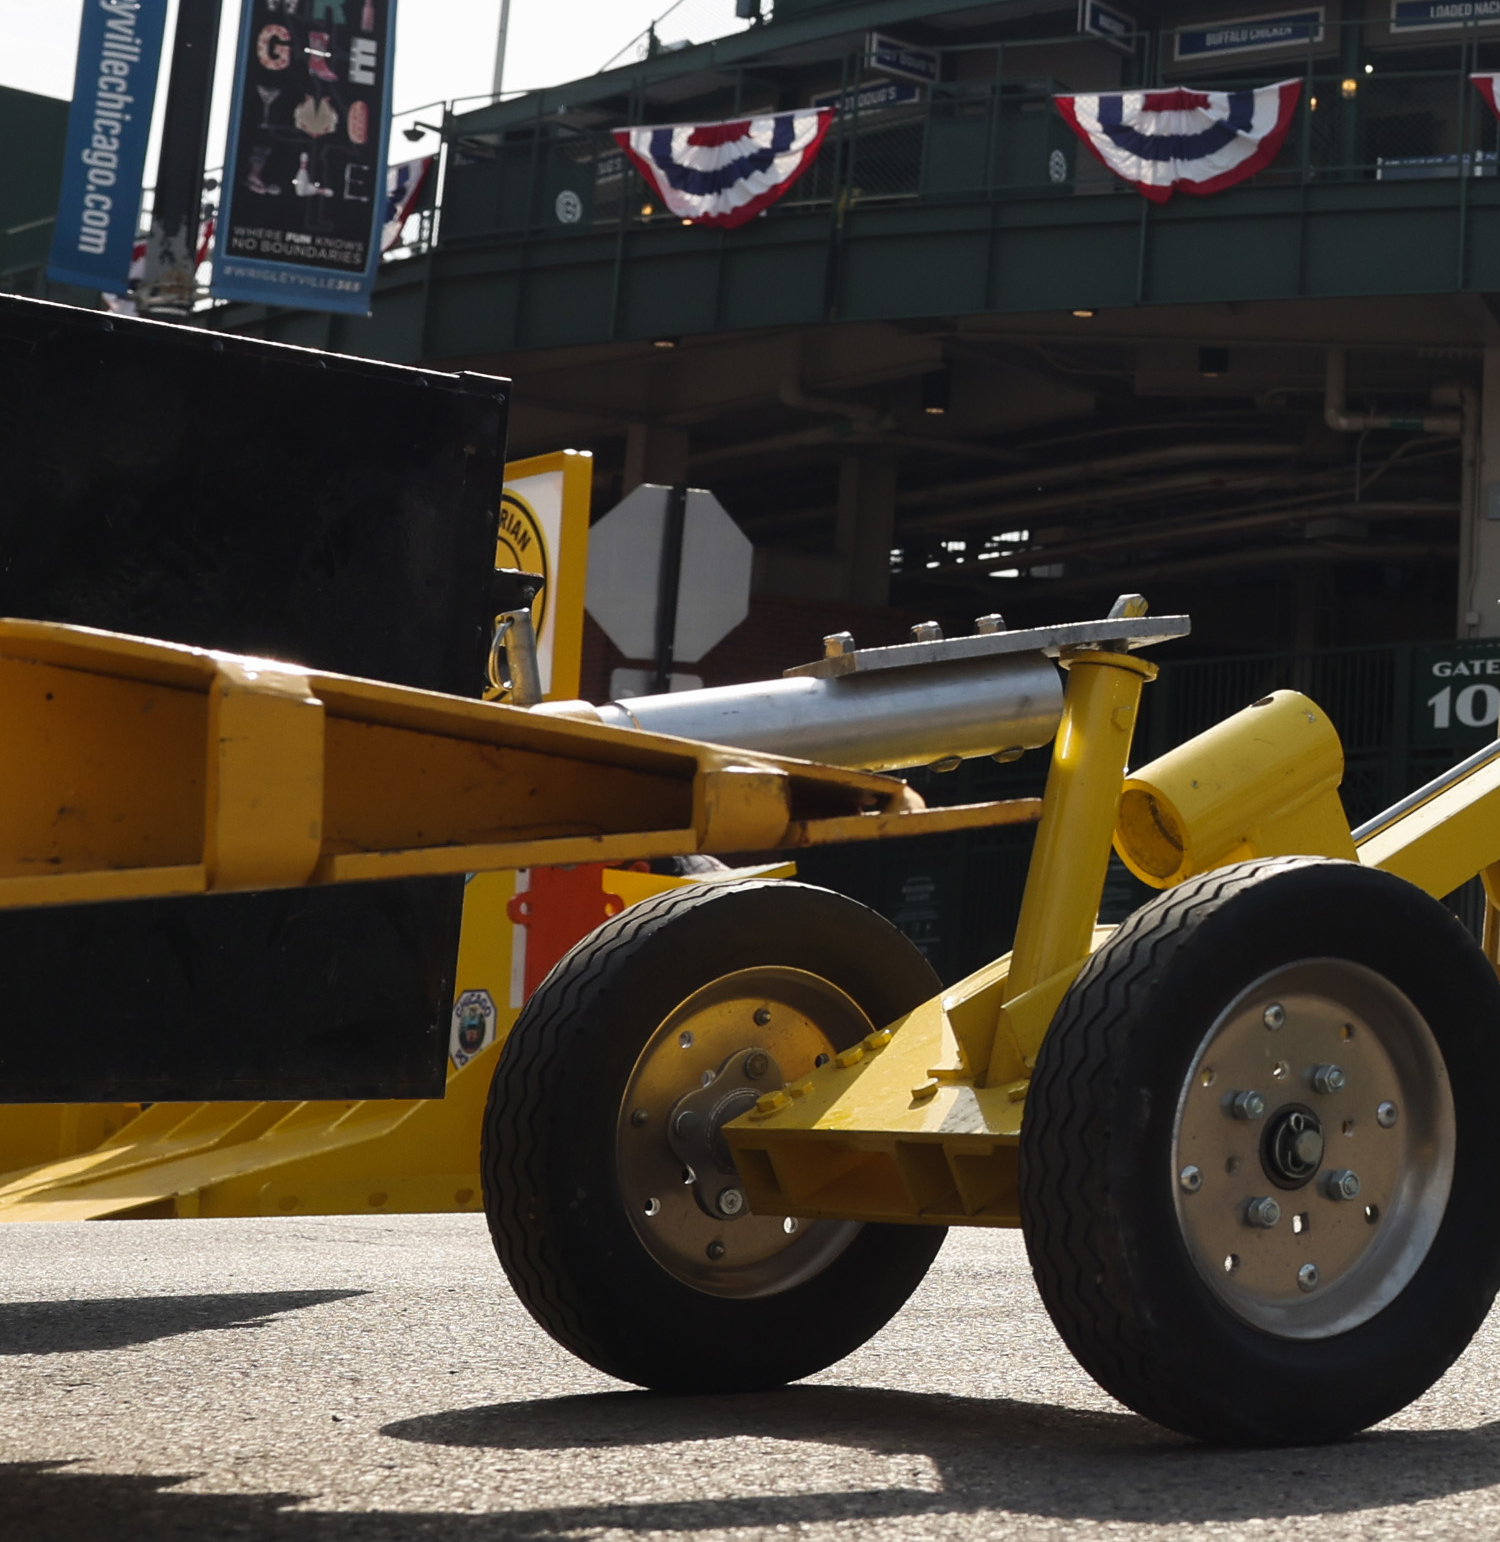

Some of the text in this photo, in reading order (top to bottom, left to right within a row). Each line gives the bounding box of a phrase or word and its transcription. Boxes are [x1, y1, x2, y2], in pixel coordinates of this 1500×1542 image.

[1430, 2, 1473, 19] LOADED
[233, 226, 364, 251] WHERE FUN KNOWS
[231, 238, 363, 266] NO BOUNDARIES
[223, 265, 362, 294] #WRIGLEYVILLE365
[1432, 659, 1500, 677] GATE
[1427, 684, 1500, 729] 10
